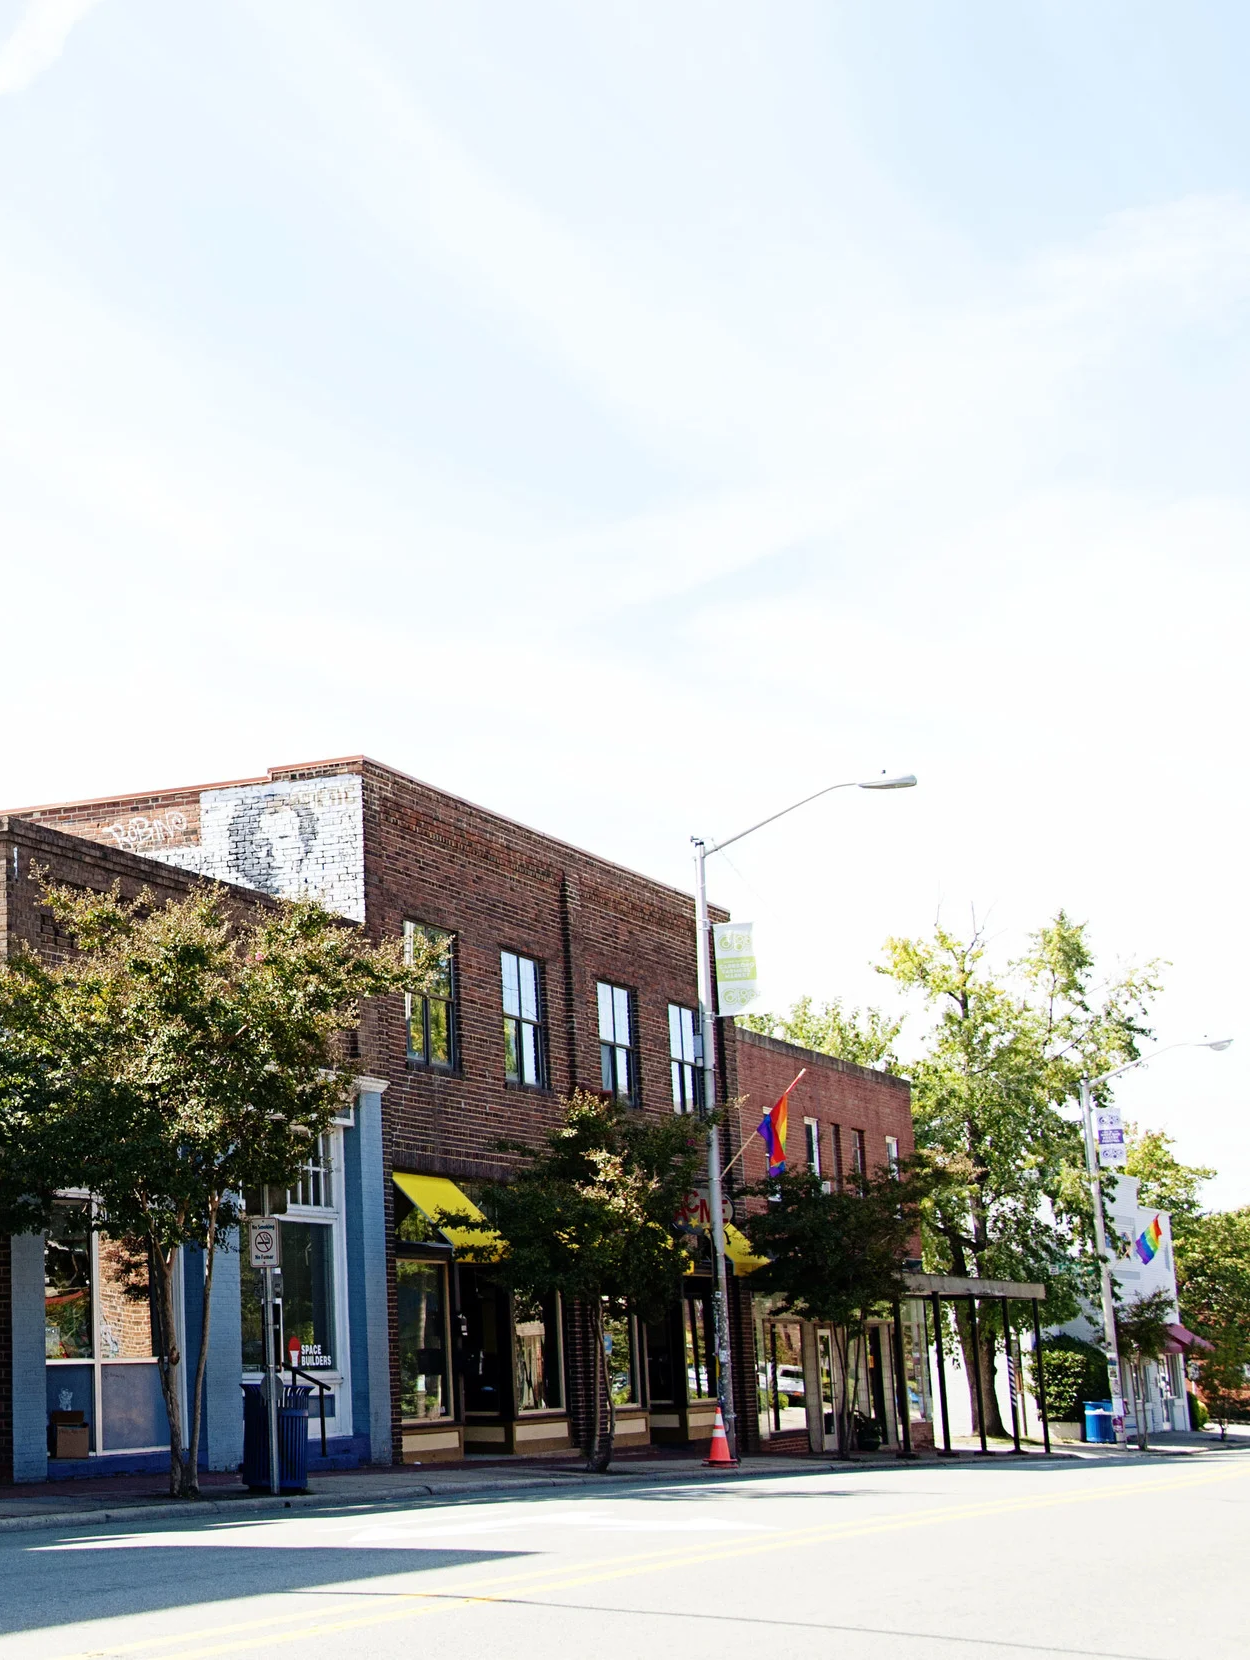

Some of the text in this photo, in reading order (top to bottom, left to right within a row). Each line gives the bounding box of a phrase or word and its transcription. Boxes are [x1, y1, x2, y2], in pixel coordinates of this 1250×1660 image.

[673, 1189, 729, 1224] ACME
[258, 1223, 275, 1231] Smoking
[301, 1344, 322, 1355] SPACE
[301, 1355, 332, 1366] BUILDERS
